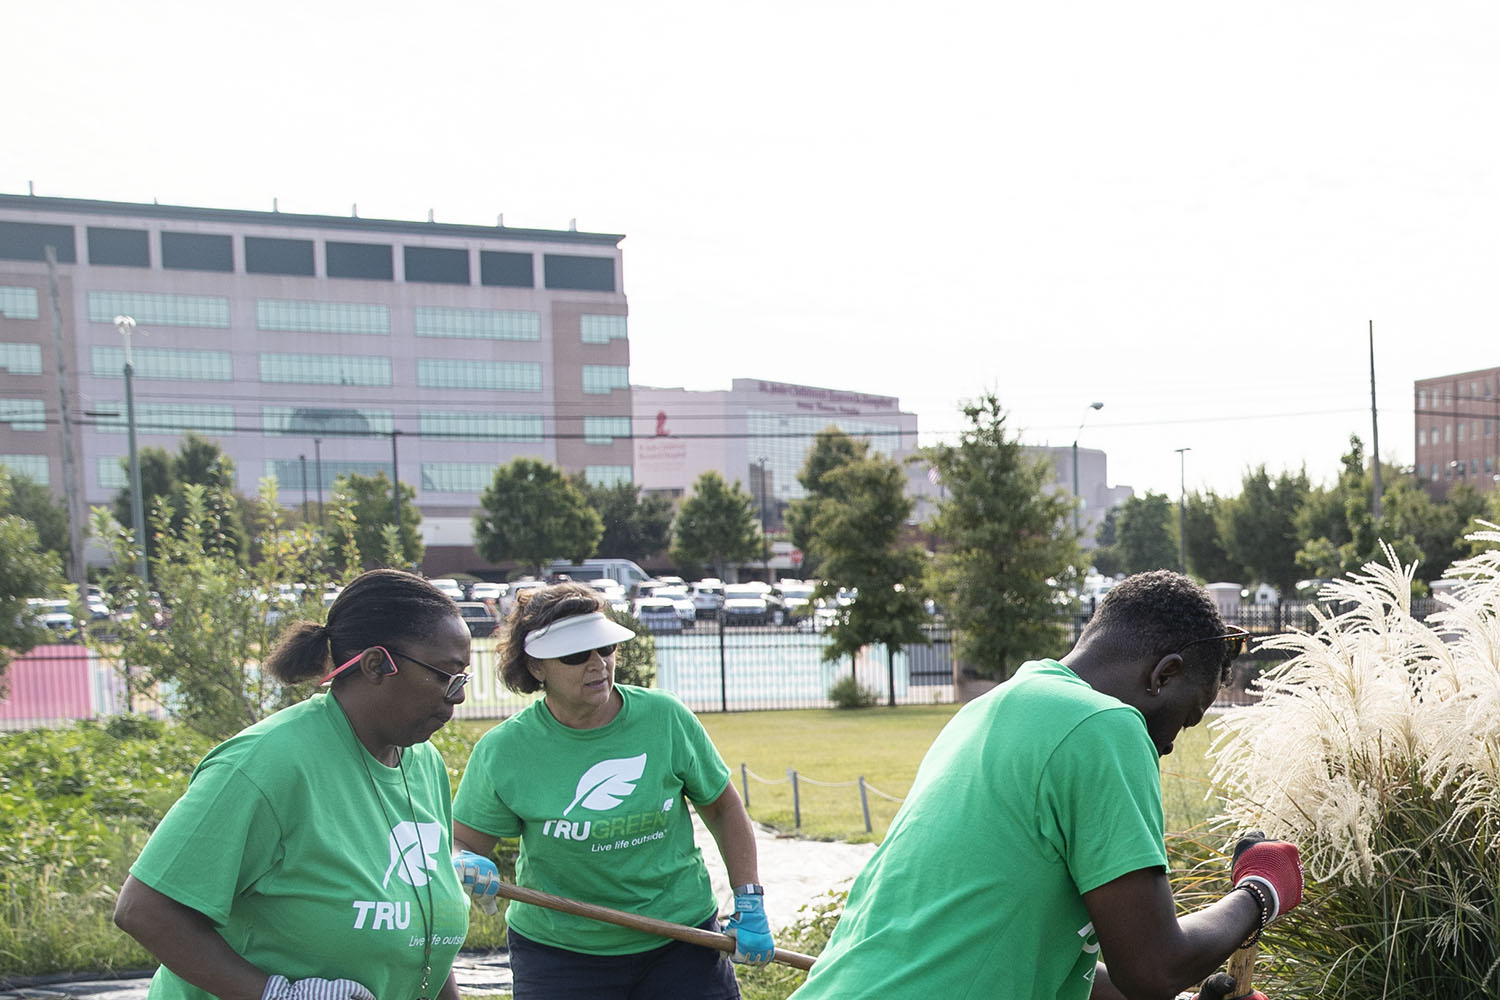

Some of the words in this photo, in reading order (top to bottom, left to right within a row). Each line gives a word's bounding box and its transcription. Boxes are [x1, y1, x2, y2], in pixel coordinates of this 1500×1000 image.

[542, 810, 669, 841] TRUGREEN
[591, 843, 612, 852] Live
[614, 839, 630, 850] life
[408, 935, 425, 947] Live
[427, 934, 441, 945] ife
